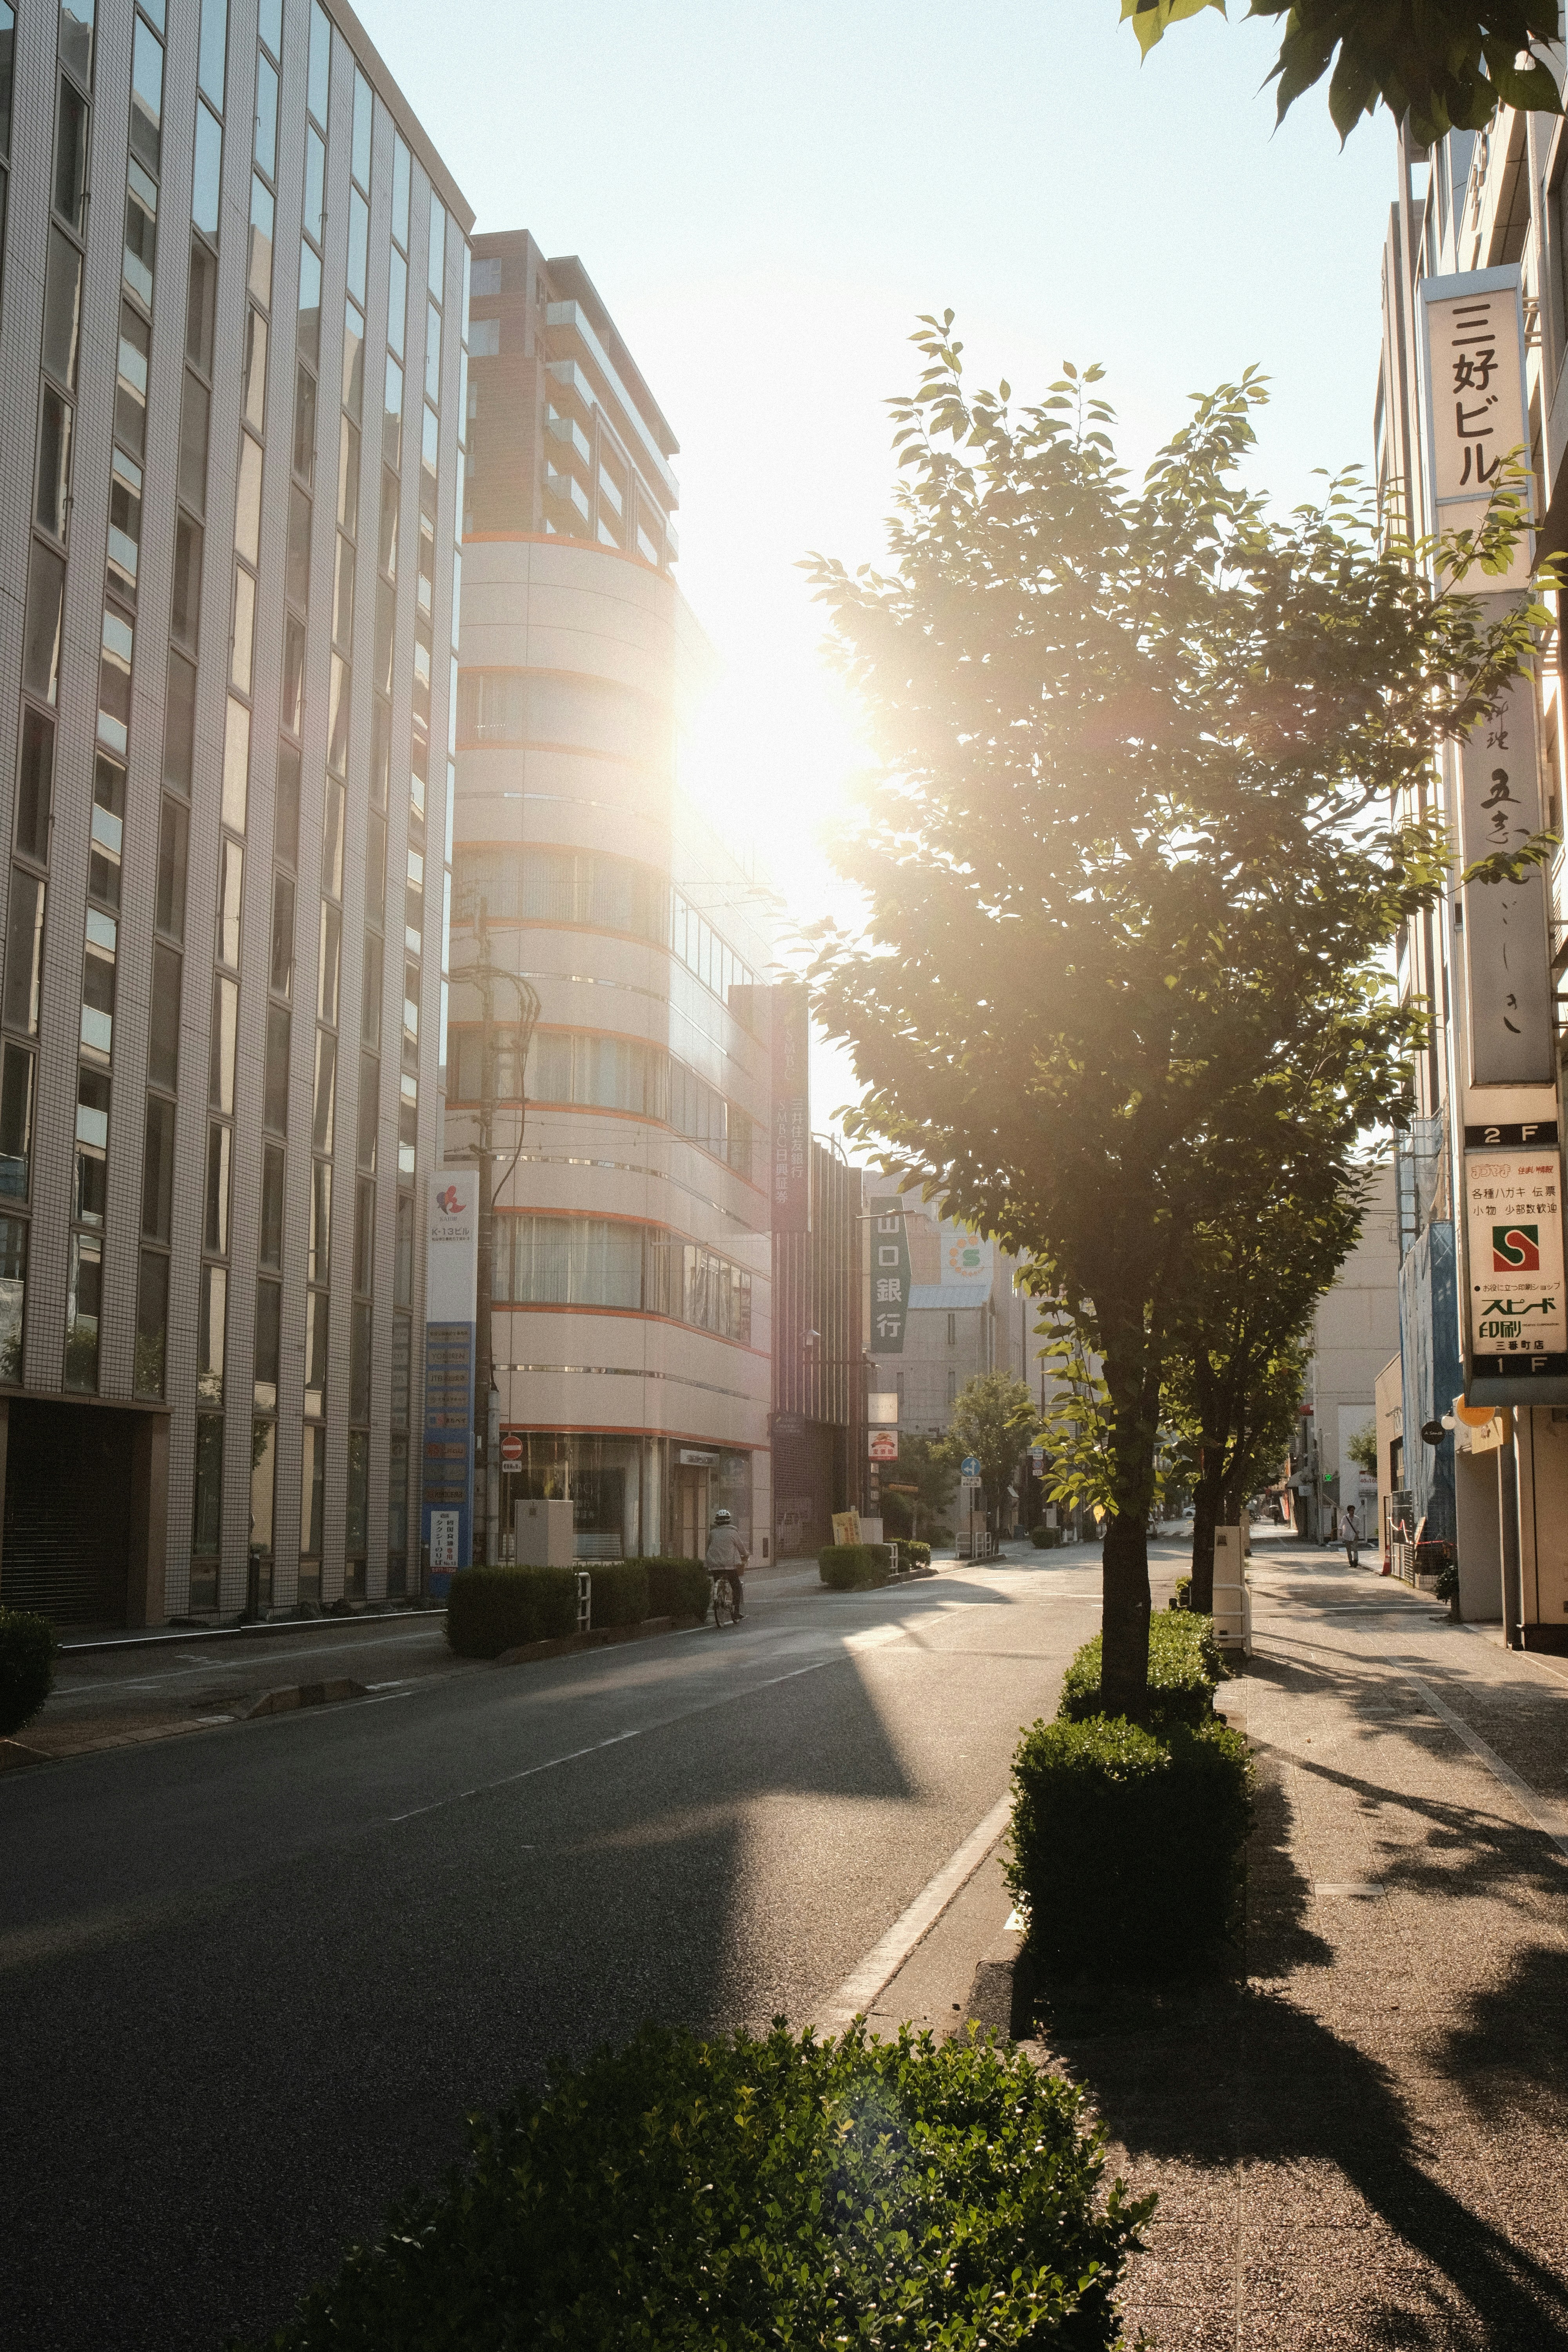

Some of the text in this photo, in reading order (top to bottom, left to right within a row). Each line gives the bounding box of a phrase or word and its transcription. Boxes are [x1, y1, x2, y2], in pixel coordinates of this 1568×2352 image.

[1451, 303, 1501, 486] 三好ビル
[784, 1029, 796, 1080] SMBC
[791, 1098, 804, 1178] 三井住友銀行
[776, 1099, 788, 1204] SMBC日興証券
[1472, 1185, 1556, 1200] 各種ハガキ 伝票
[1473, 1202, 1557, 1216] 小物 少部数歓迎
[877, 1215, 902, 1338] 山口銀行
[1482, 1281, 1561, 1292] お役に立つ印刷ショップ
[1481, 1297, 1557, 1316] スピード
[1479, 1321, 1521, 1338] 印刷
[1495, 1340, 1544, 1351] 三番町店
